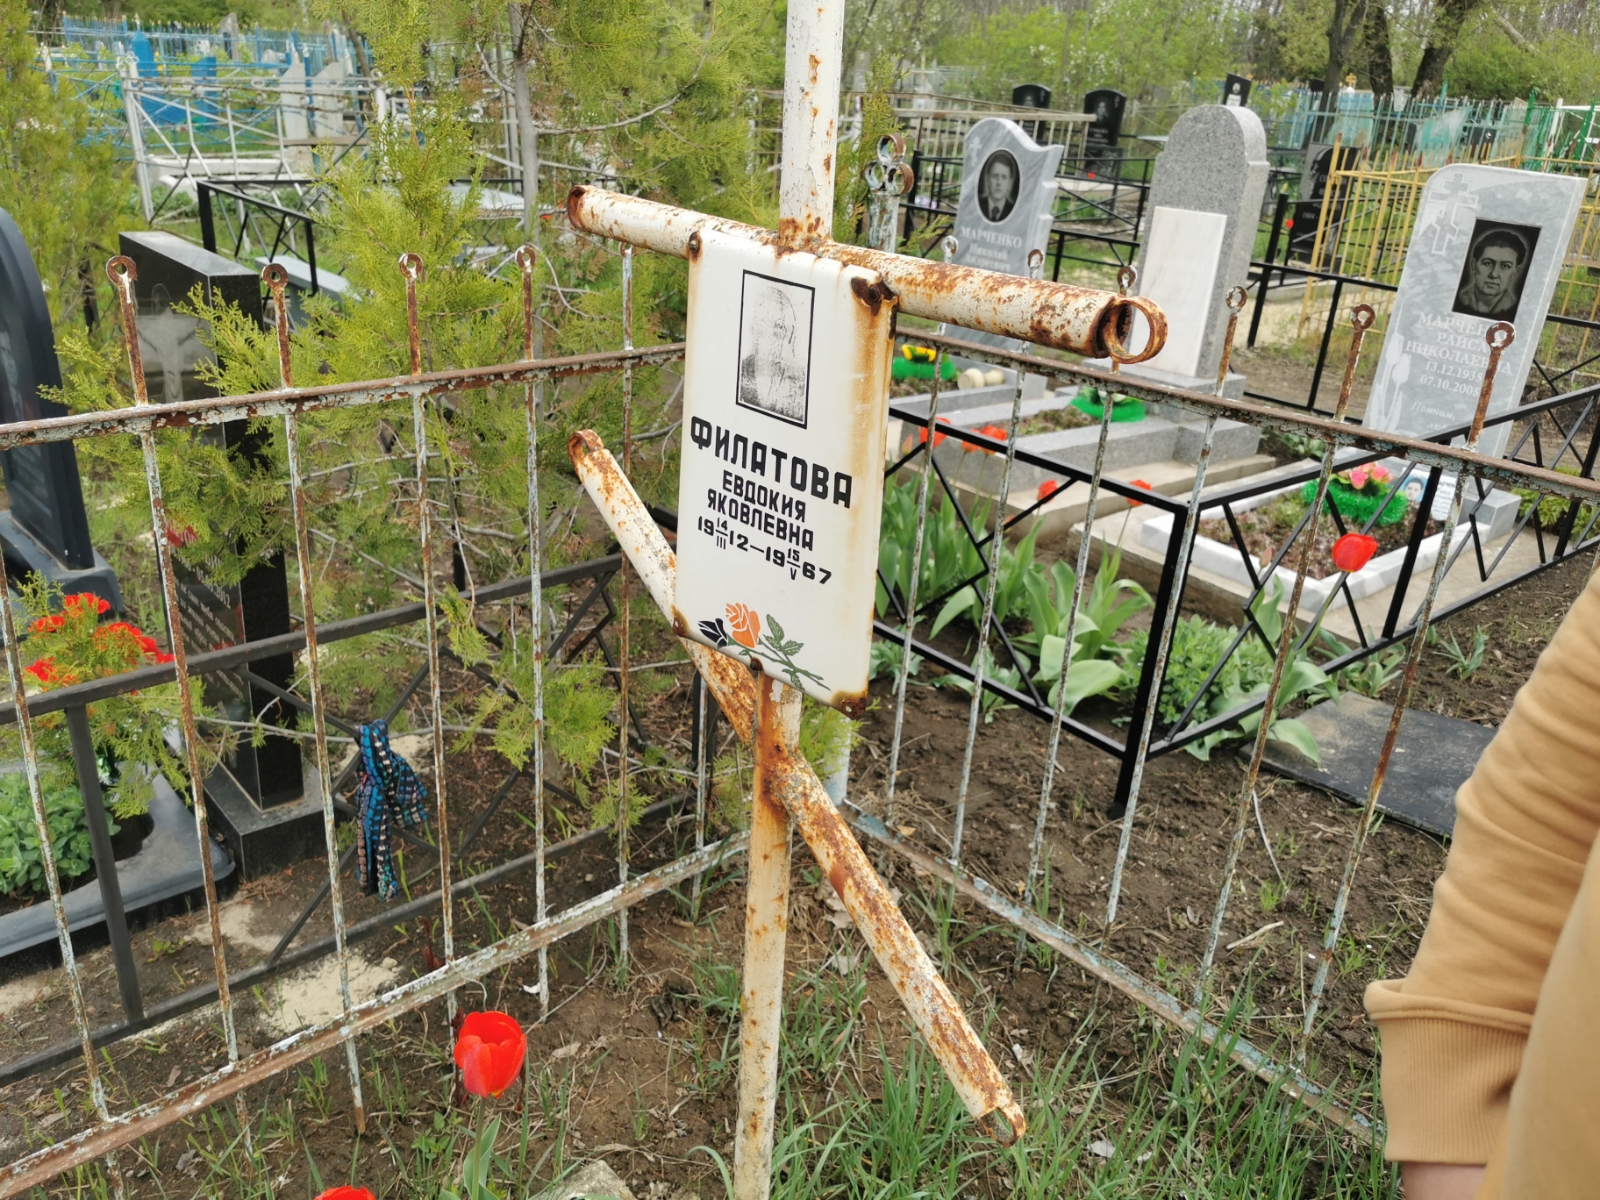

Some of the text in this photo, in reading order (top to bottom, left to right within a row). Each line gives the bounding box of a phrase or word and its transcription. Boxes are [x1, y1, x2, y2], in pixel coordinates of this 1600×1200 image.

[960, 226, 1022, 248] МАРЧЕНКО
[1419, 311, 1488, 338] МАРЧЕН
[1437, 332, 1487, 353] РАИСА
[1425, 361, 1483, 383] 13.12.1935
[1420, 374, 1480, 397] 07.10.2005
[690, 415, 853, 509] ФИЛАТОВА
[722, 469, 806, 523] ЕВДОКИЯ
[707, 488, 814, 551] ЯКОВЛЕВНА
